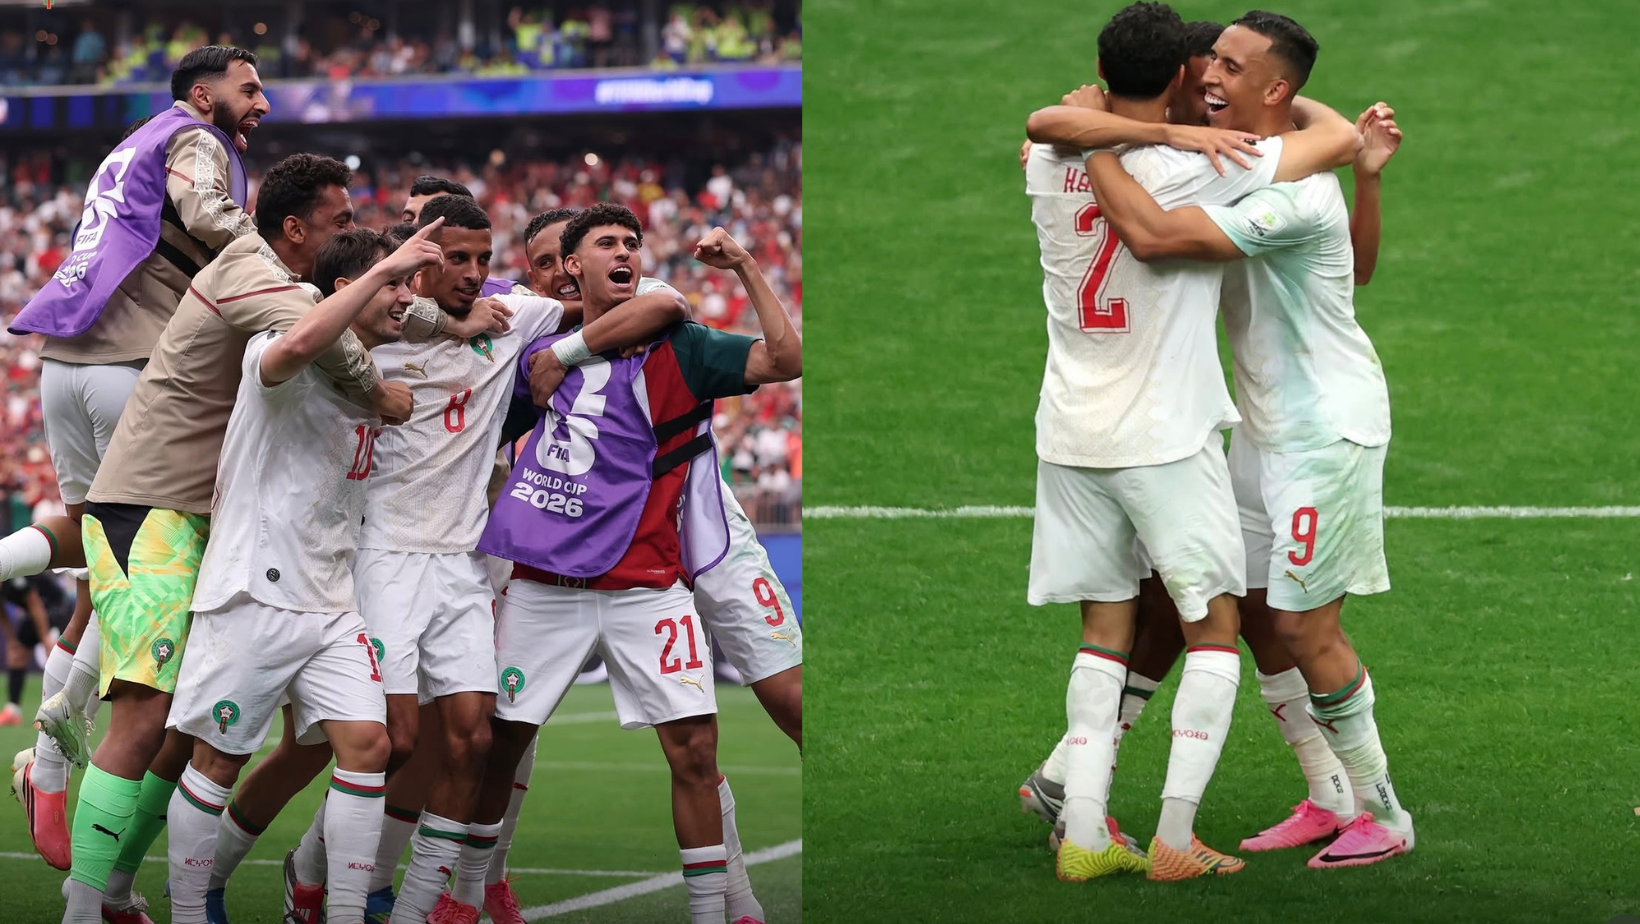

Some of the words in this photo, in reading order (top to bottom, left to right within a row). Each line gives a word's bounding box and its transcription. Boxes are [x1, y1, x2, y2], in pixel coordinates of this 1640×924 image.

[1063, 167, 1091, 193] HA
[76, 231, 98, 244] FIFA
[1075, 202, 1131, 334] 2
[443, 388, 472, 433] 8
[346, 424, 374, 480] 10
[510, 481, 583, 518] 2026
[522, 467, 563, 490] WORLD
[563, 480, 588, 496] CUP
[1287, 507, 1318, 567] 9
[752, 577, 785, 627] 9
[356, 633, 382, 682] 1
[654, 615, 703, 675] 21
